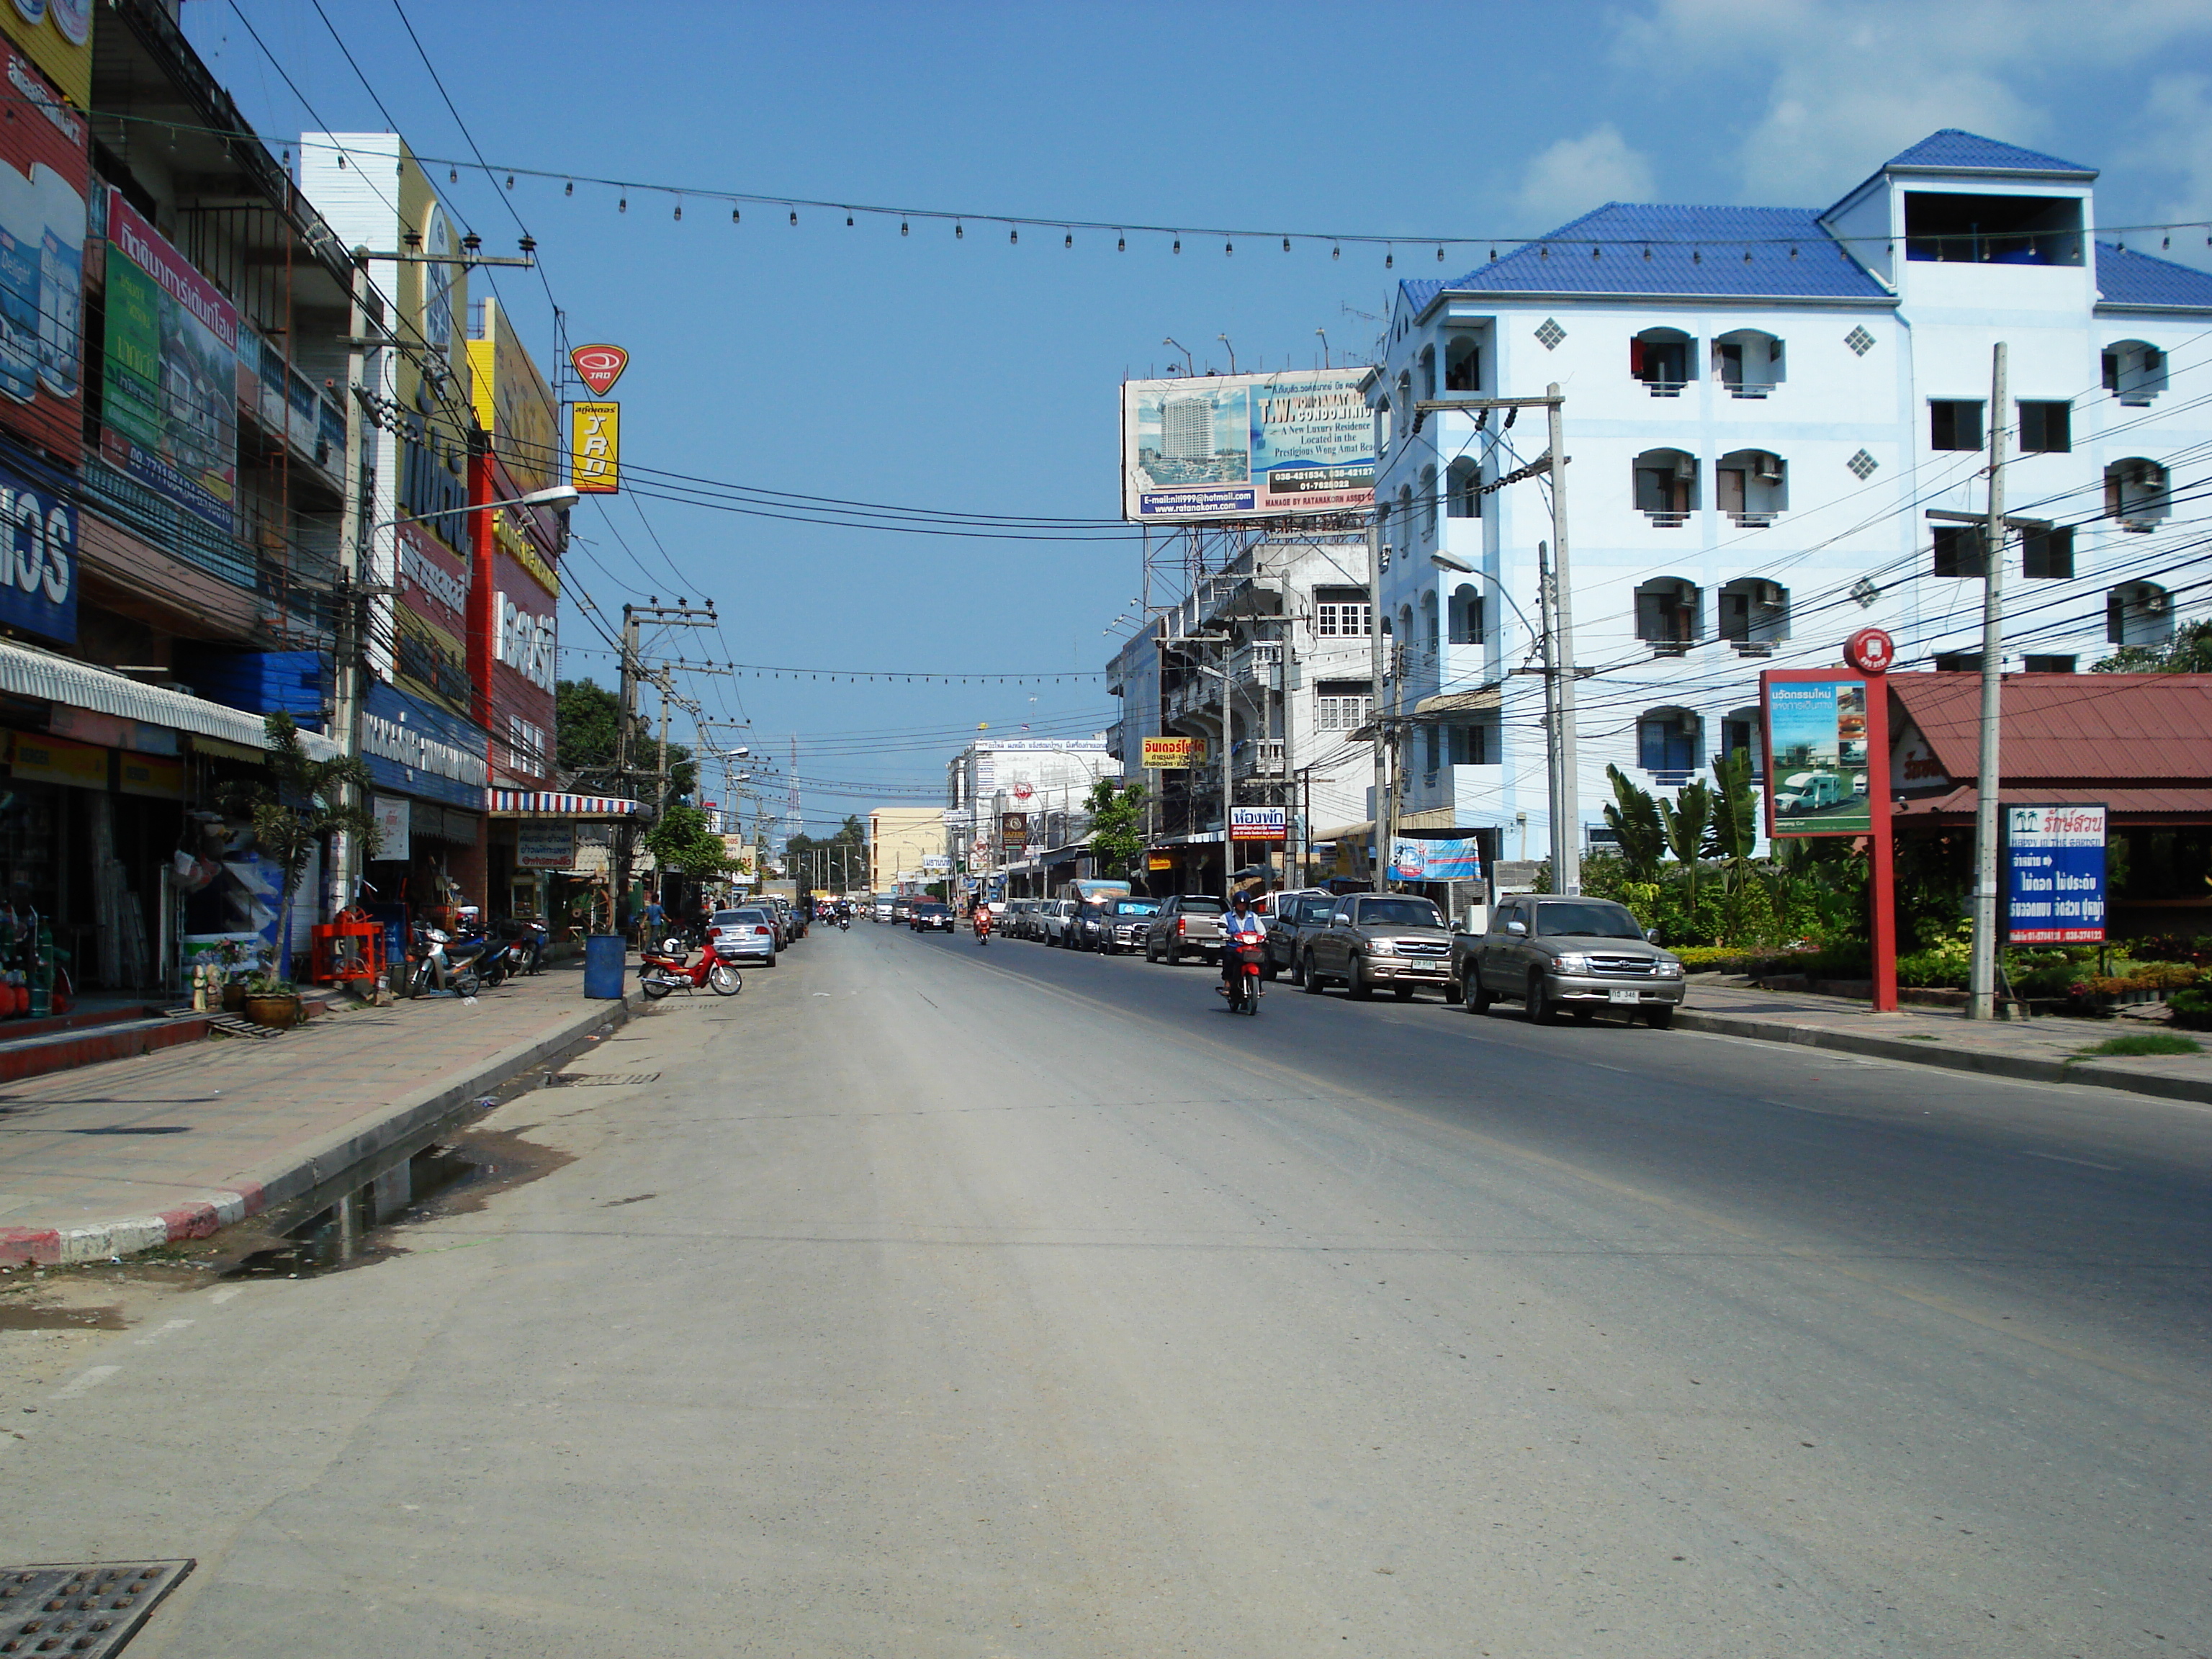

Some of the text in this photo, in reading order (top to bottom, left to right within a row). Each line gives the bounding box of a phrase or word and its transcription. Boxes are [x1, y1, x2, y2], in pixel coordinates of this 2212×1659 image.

[1289, 425, 1305, 435] New
[1307, 424, 1332, 434] Luxury
[1335, 422, 1370, 431] Residence
[1301, 433, 1357, 444] Located in the
[1274, 446, 1313, 457] Prestigious
[1316, 445, 1336, 456] Wong
[1338, 444, 1357, 453] Amat
[1144, 493, 1251, 505] E-mail:niti999@hotmail.com
[1265, 498, 1290, 507] MANAGE
[1303, 495, 1344, 505] RATANAKORN
[1346, 493, 1365, 502] ASSET
[1154, 503, 1236, 513] www.ratanakorn.com
[1860, 656, 1887, 668] BUS STOP
[1772, 686, 1832, 701] นวัตกรรมใหม่
[1233, 808, 1283, 824] ห้องพัก
[2044, 809, 2103, 832] รักษ์สวน
[2013, 852, 2041, 867] จำหน่าย
[2020, 870, 2097, 891] ไม้ดอก ไม้ประดับ
[2009, 894, 2104, 922] รับออกแบบ จัดสวน ปูหญ้า
